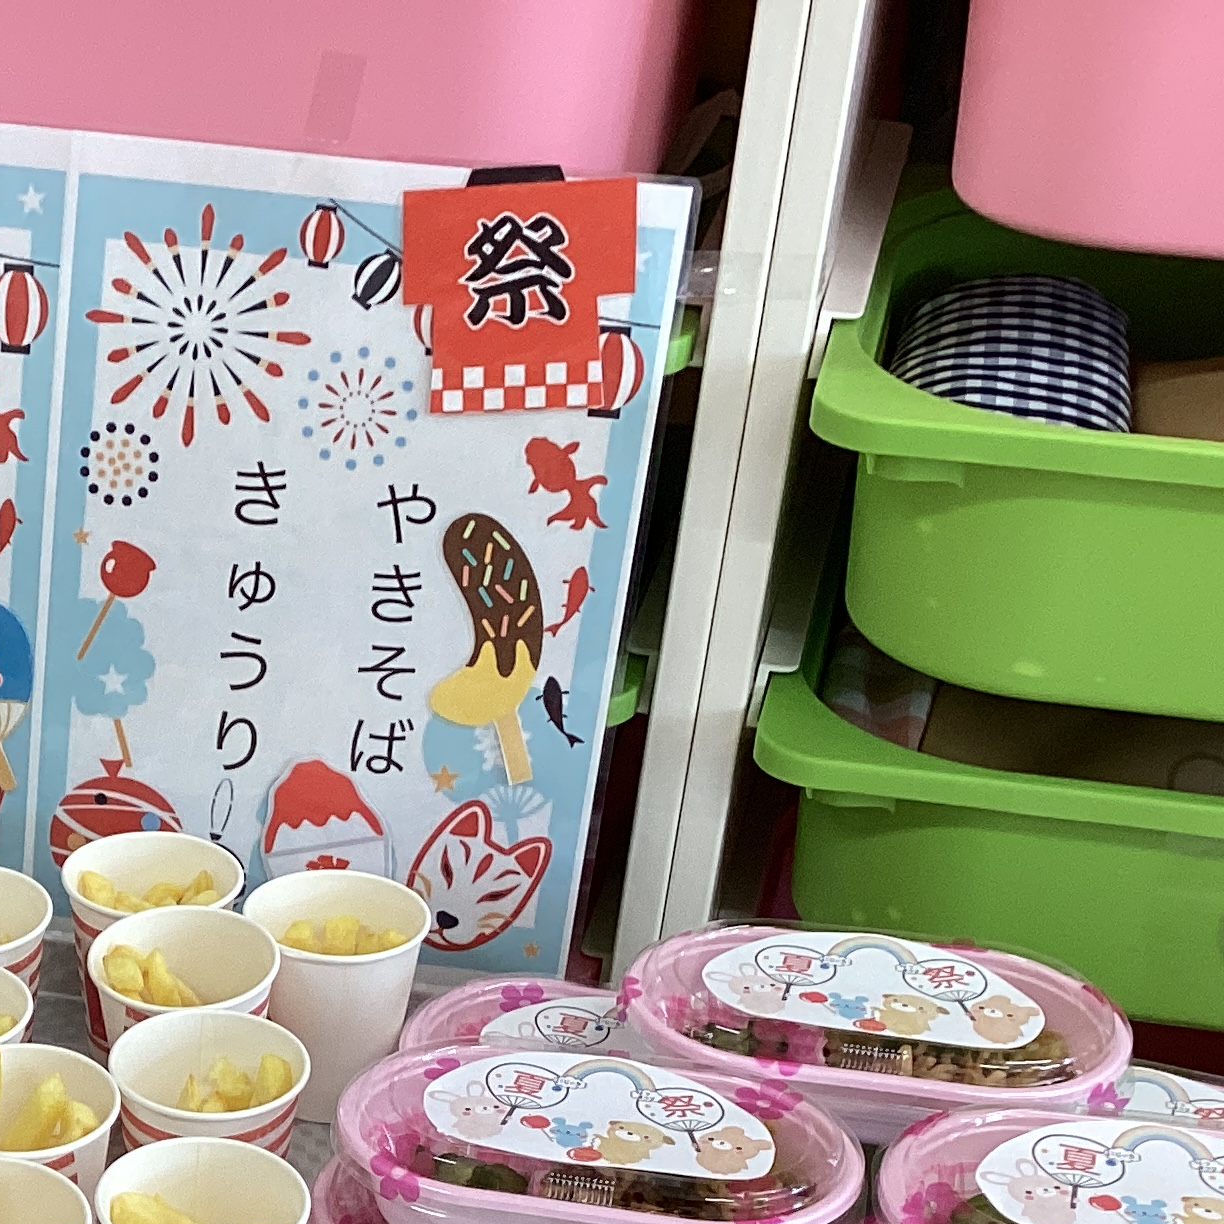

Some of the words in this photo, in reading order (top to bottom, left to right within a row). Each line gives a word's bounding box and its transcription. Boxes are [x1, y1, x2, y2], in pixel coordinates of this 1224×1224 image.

[462, 213, 573, 328] 祭
[216, 461, 286, 770] きゅうり
[350, 484, 436, 774] やきそば
[775, 951, 819, 977] 夏
[923, 965, 970, 989] 祭
[504, 1070, 552, 1099] 夏
[657, 1095, 705, 1118] 祭
[1056, 1143, 1104, 1176] 夏
